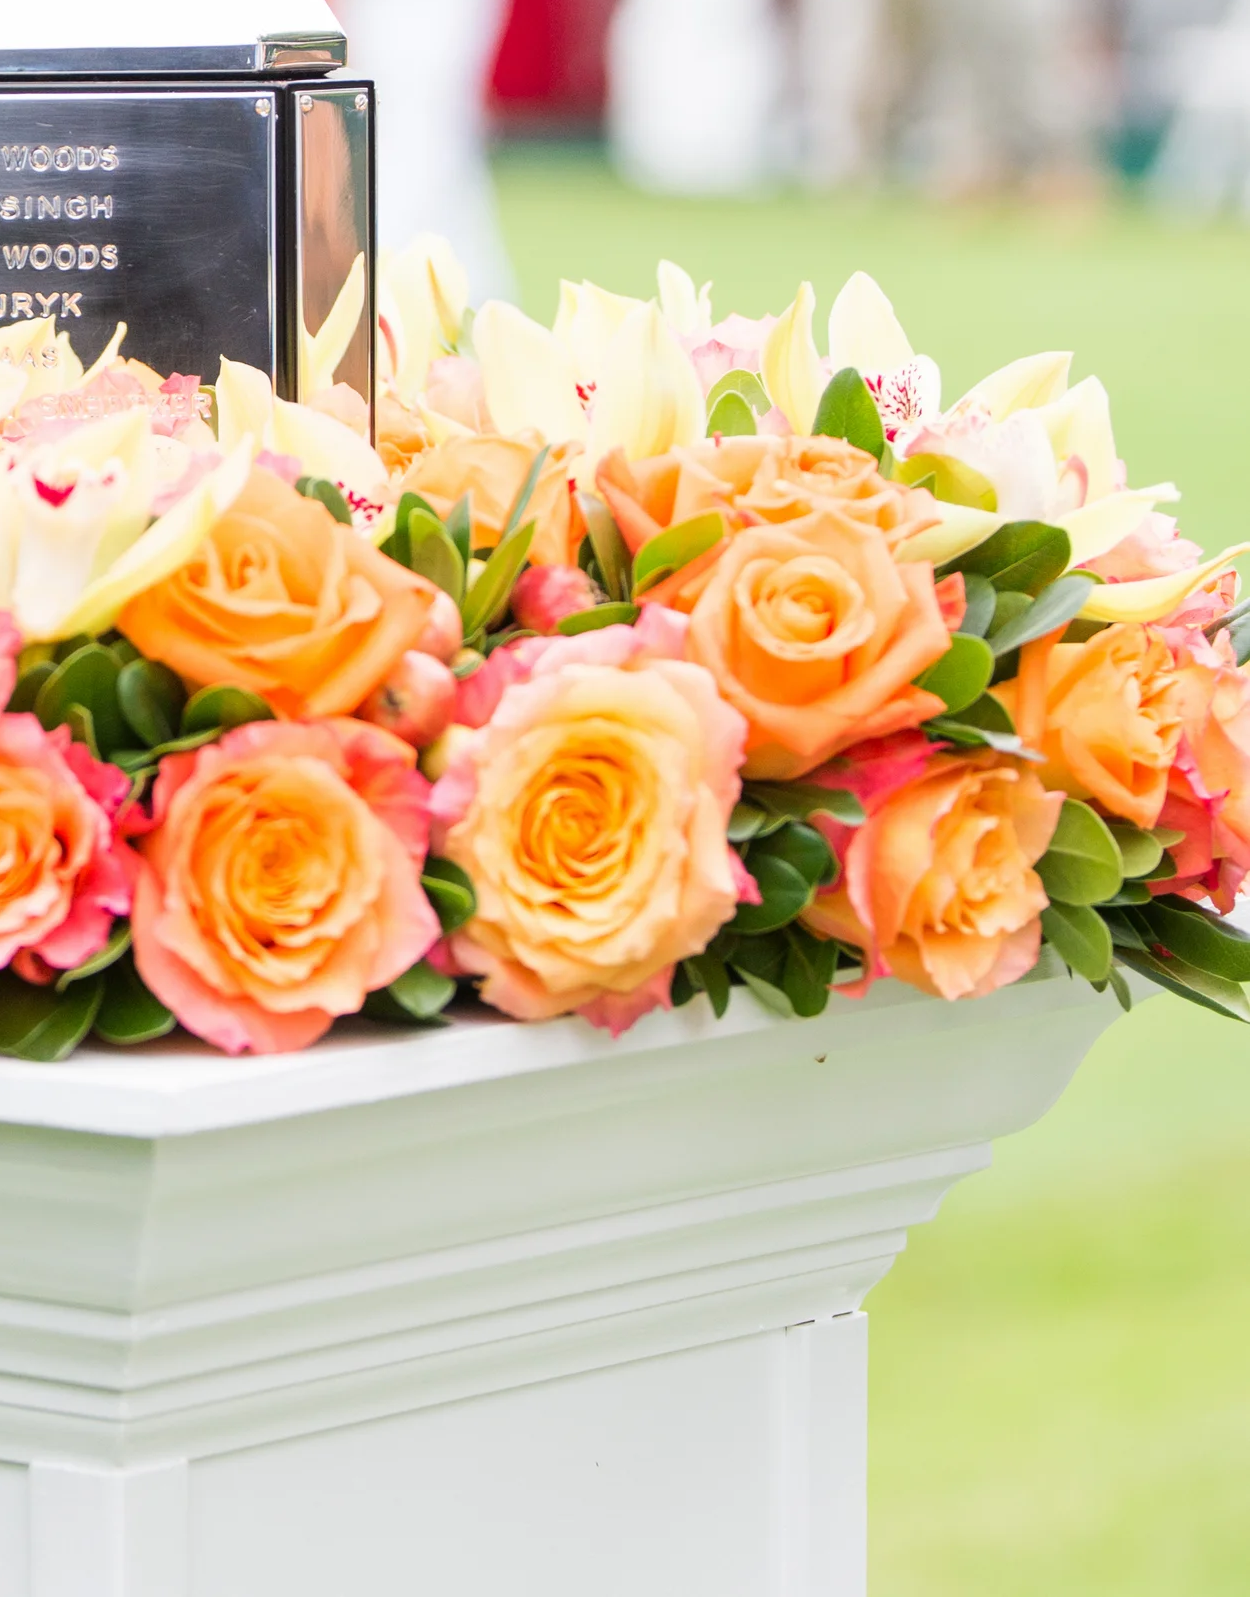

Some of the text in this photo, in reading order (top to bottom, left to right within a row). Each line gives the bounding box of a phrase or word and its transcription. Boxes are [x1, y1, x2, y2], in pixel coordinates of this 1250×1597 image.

[1, 145, 120, 172] WOODS
[0, 195, 114, 220] SINGH
[2, 244, 119, 270] WOODS
